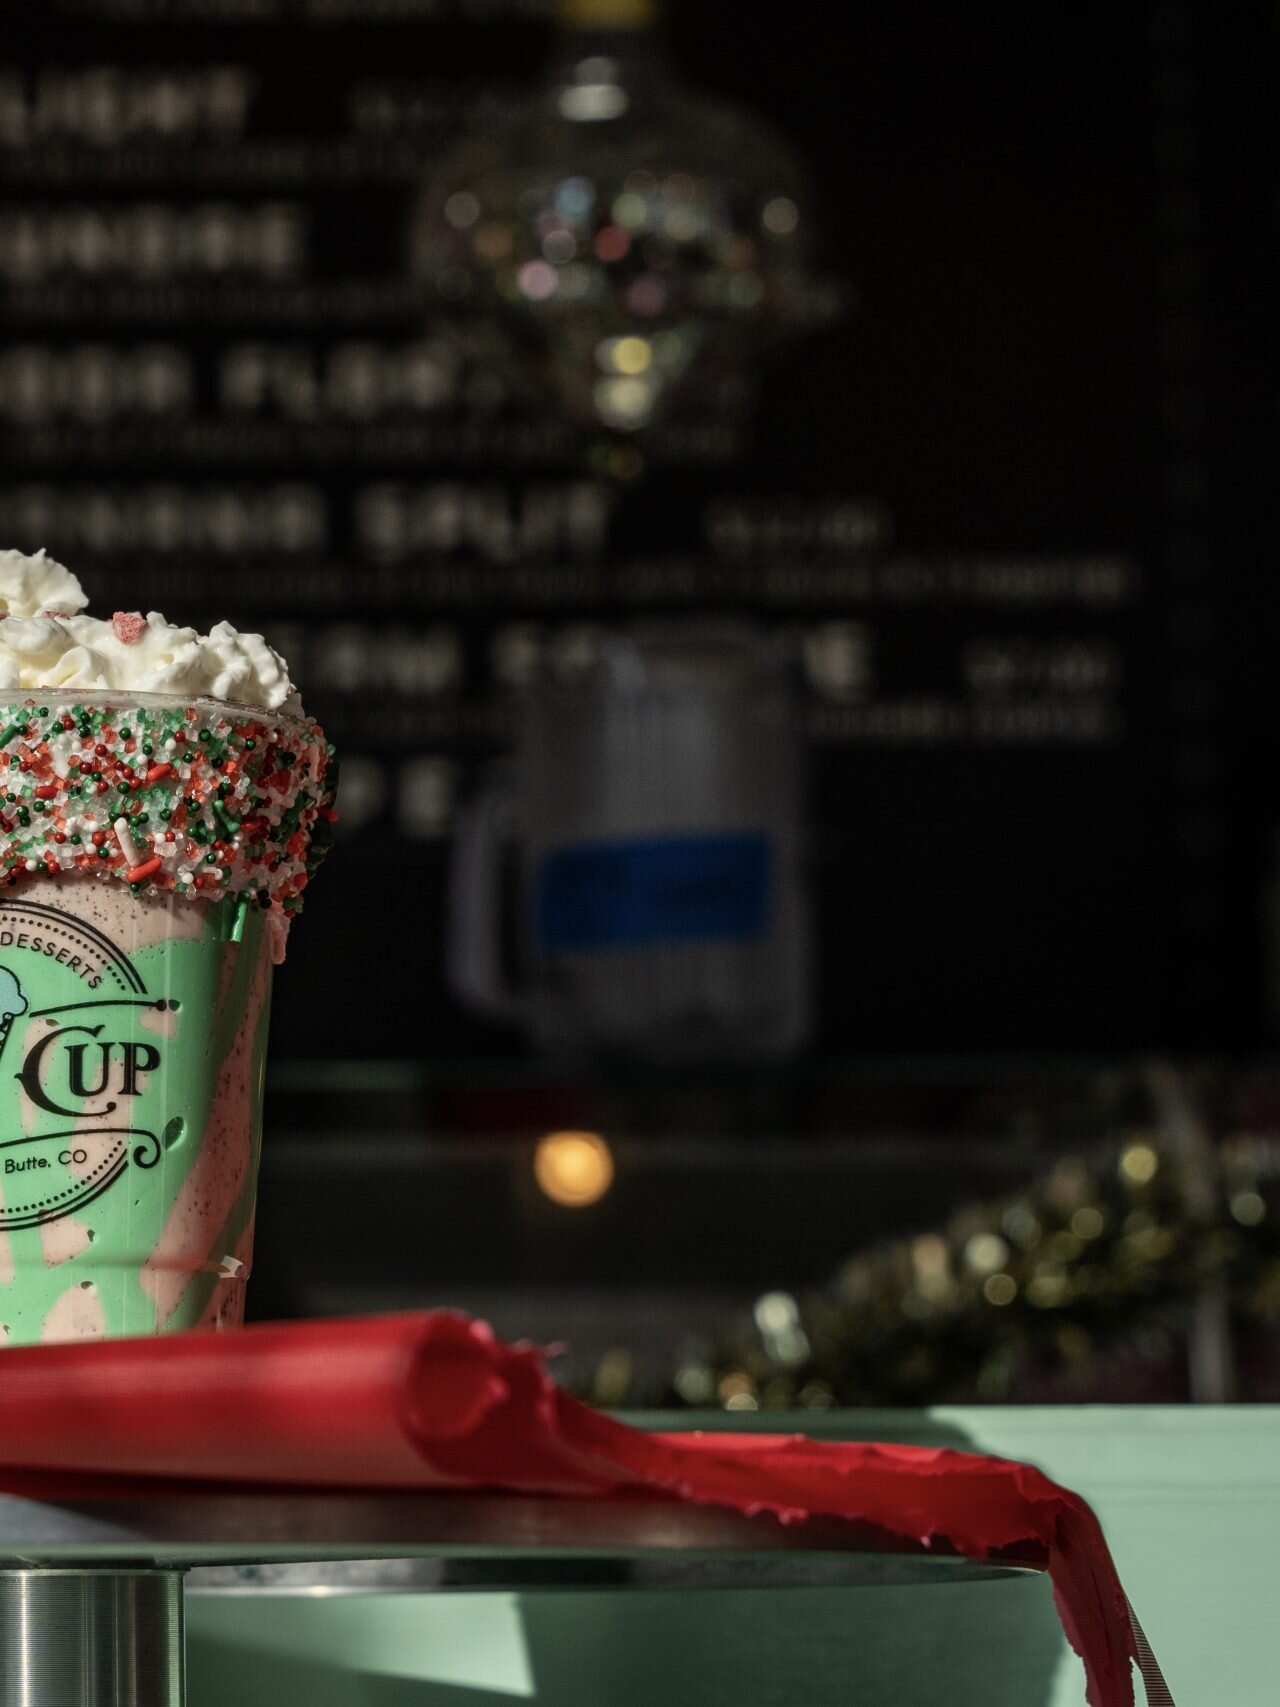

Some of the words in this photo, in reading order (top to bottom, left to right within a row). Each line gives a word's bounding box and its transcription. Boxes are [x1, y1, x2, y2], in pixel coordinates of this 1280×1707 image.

[0, 931, 103, 990] DESSERTS
[14, 1024, 161, 1117] CUP
[57, 1149, 88, 1167] CO
